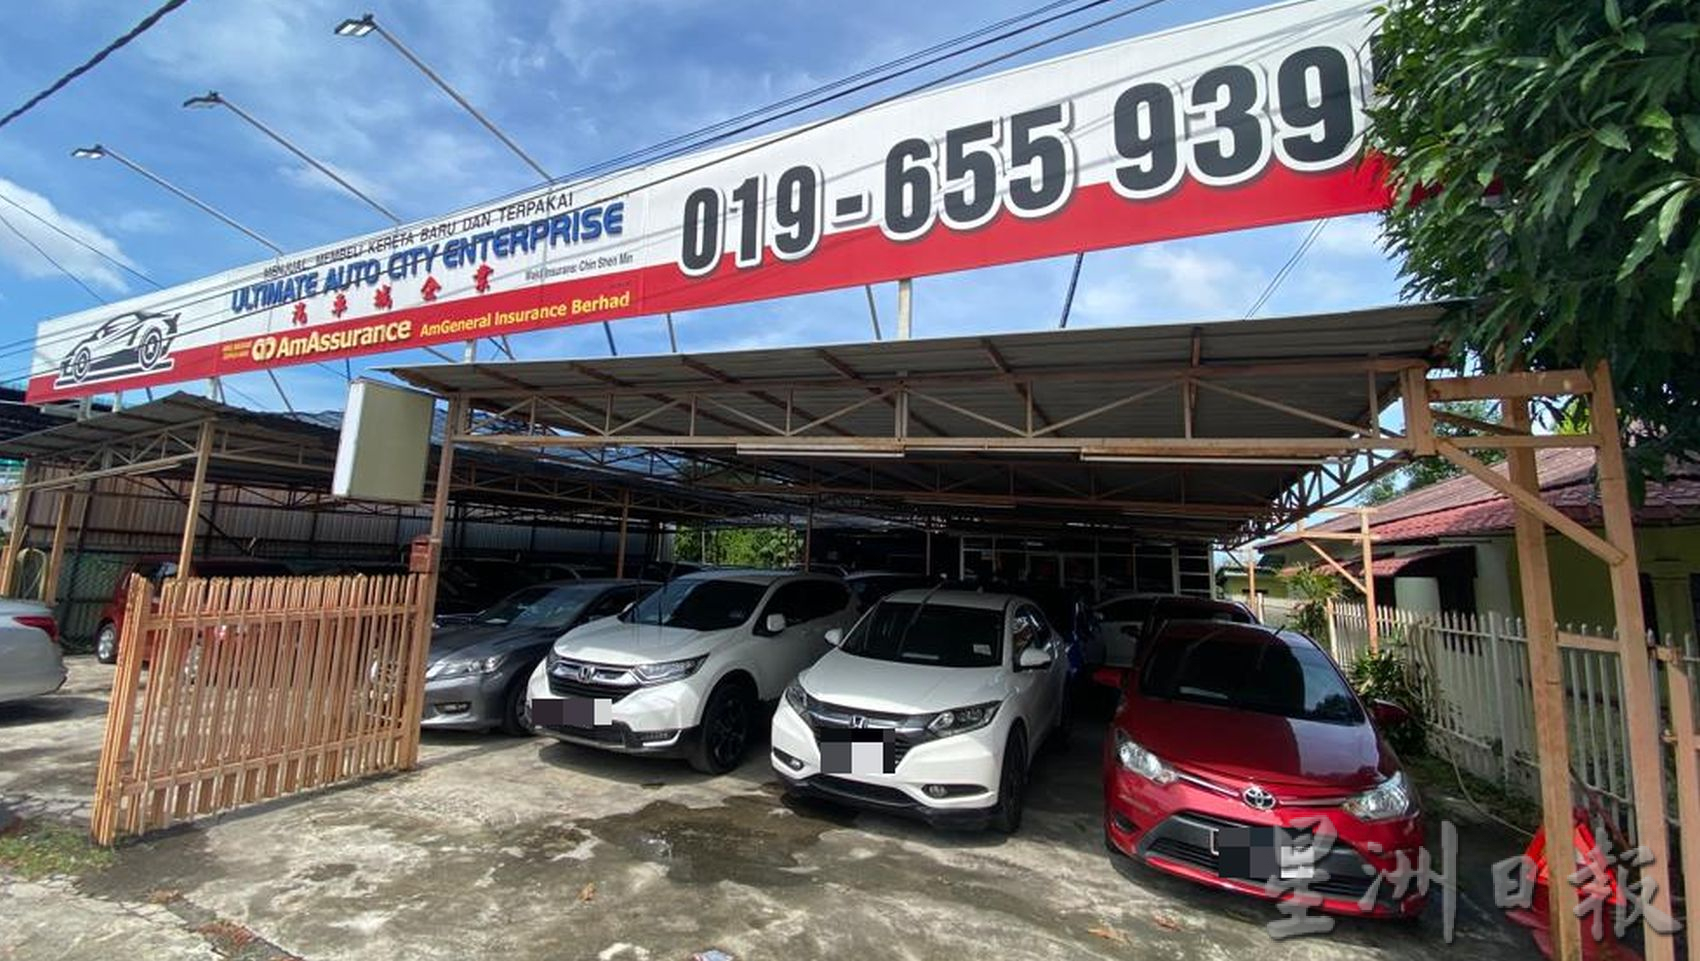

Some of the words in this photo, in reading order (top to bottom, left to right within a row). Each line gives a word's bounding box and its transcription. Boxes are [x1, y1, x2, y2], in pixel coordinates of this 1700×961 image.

[1112, 38, 1384, 193] 939
[367, 233, 414, 255] KERETA
[419, 221, 456, 242] BARU
[463, 213, 491, 233] DAN
[499, 192, 573, 223] TERPAKAI
[231, 271, 319, 313] ULTIMATE
[324, 258, 380, 294] AUTO
[388, 238, 440, 280] CITY
[442, 202, 625, 268] ENTERPRISE
[579, 259, 598, 272] Chin
[619, 252, 633, 265] Min
[275, 319, 412, 358] AmAssurance
[420, 312, 491, 338] AmGeneral
[494, 300, 567, 326] Insurance
[572, 291, 631, 315] Berhad
